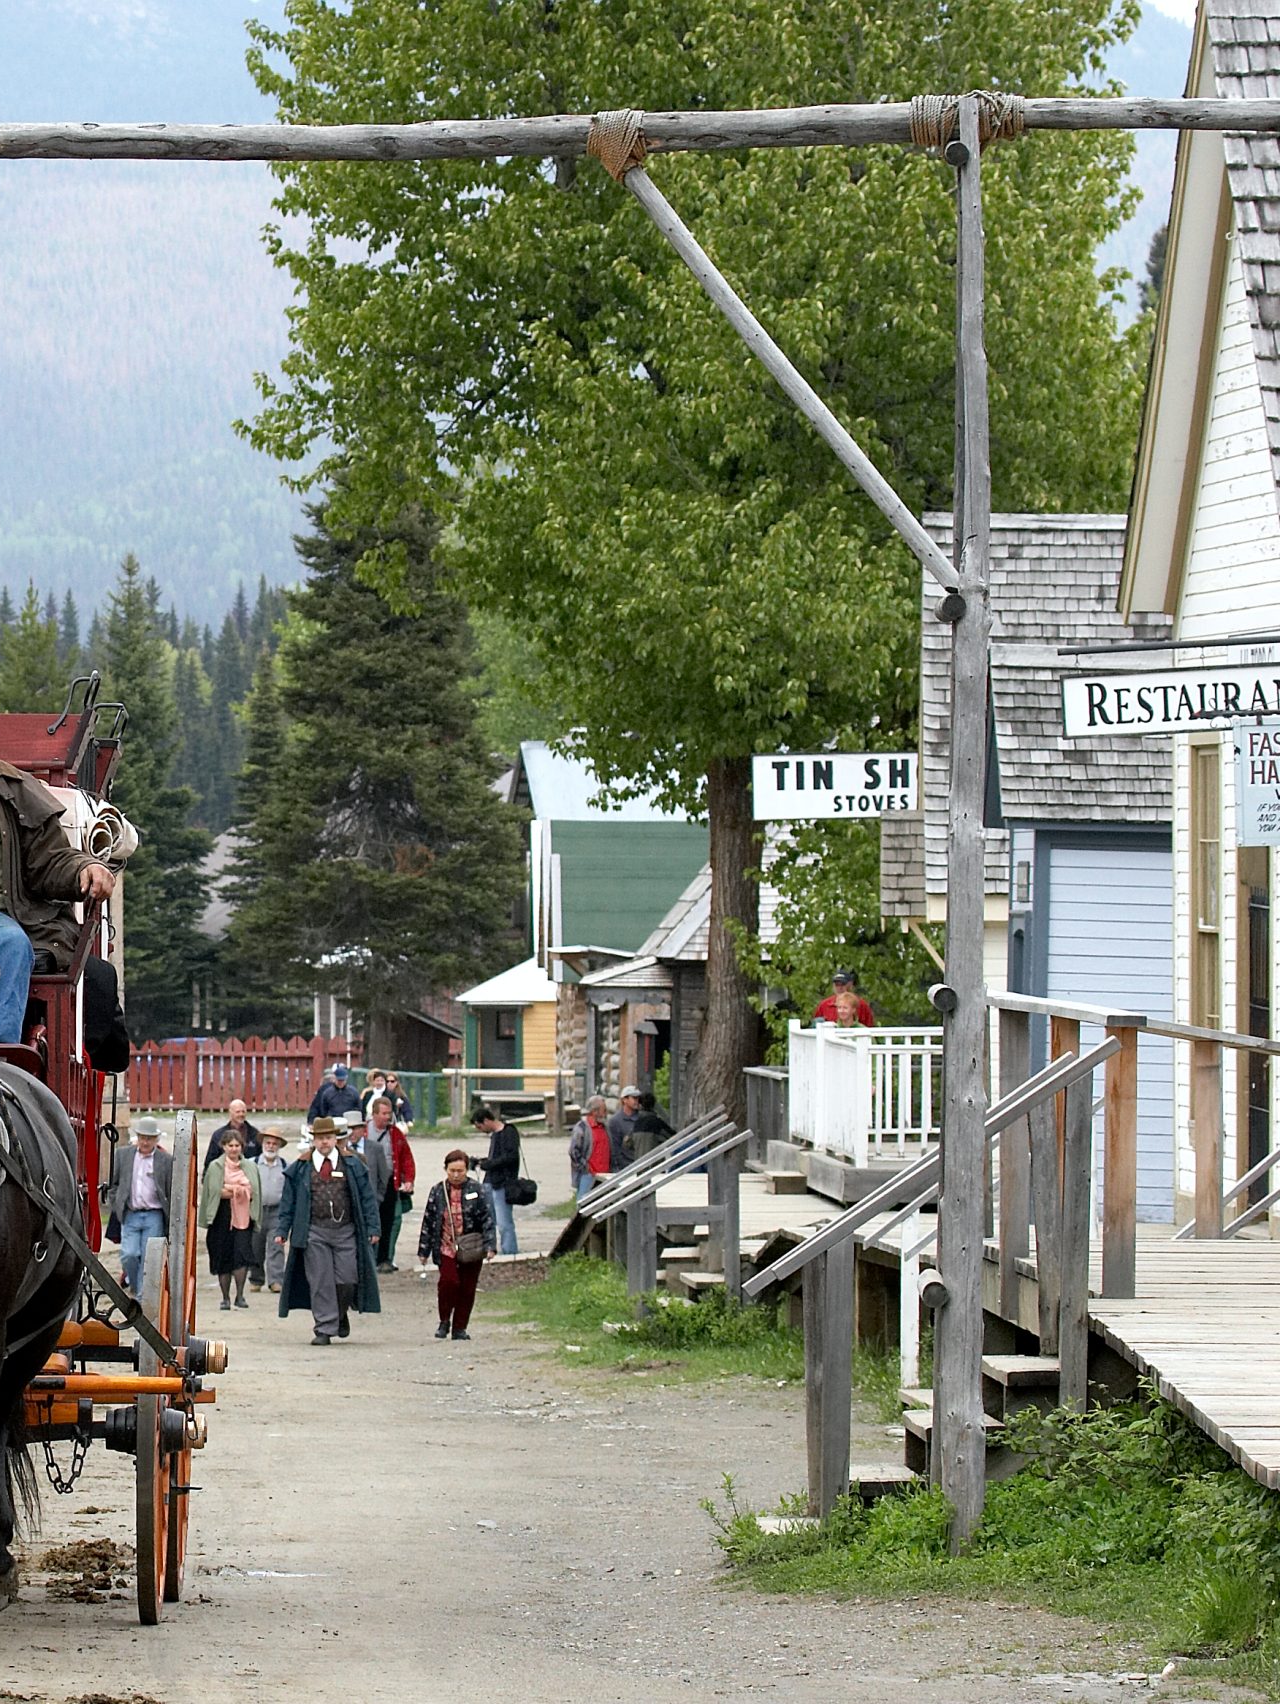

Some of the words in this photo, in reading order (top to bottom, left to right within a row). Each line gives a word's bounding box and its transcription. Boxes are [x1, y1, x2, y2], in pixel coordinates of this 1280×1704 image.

[771, 760, 833, 791] TIN
[864, 759, 918, 790] SH
[833, 794, 909, 812] STOVES
[1257, 813, 1277, 822] AND
